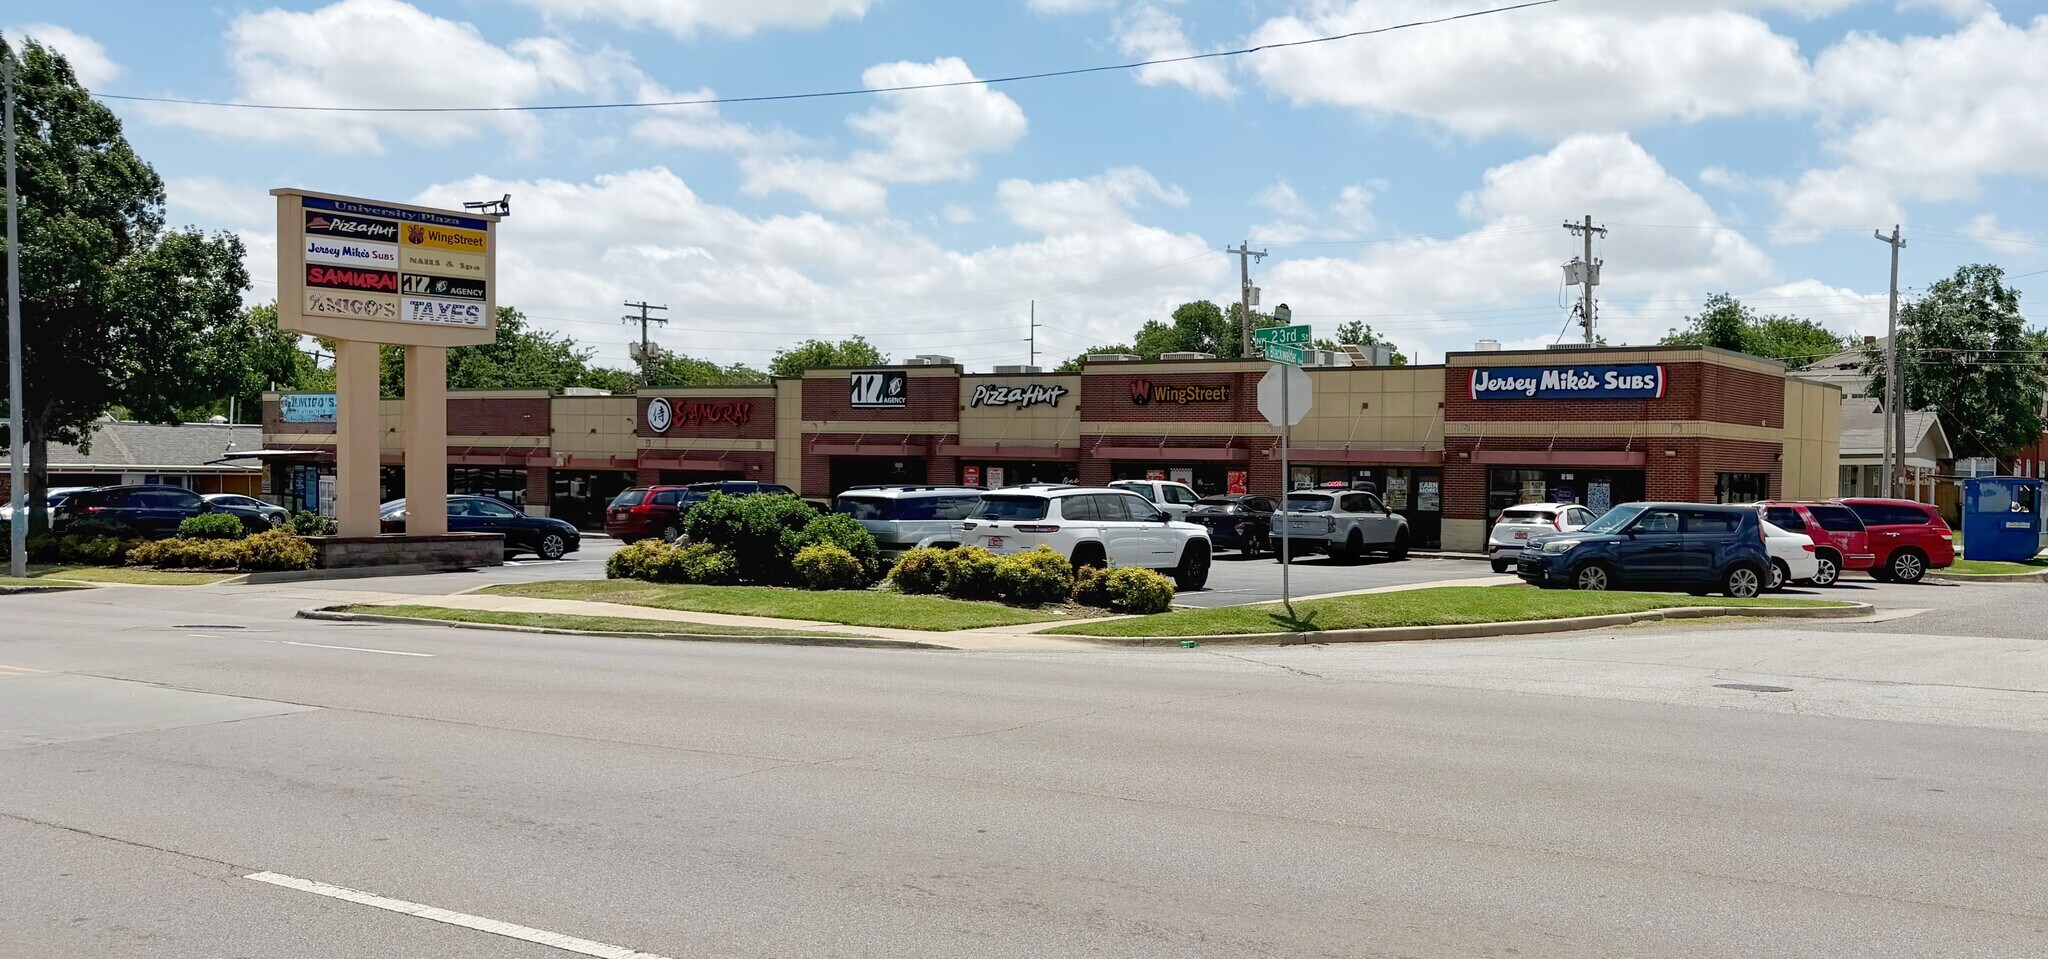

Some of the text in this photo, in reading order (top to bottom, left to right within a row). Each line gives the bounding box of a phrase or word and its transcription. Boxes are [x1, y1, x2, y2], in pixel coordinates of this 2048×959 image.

[334, 201, 460, 225] University Plaza
[428, 231, 483, 246] WingStreet
[308, 243, 340, 258] Jersey
[342, 246, 370, 258] Mike's
[308, 267, 396, 290] SAMURAI
[450, 287, 484, 296] AGENCY
[409, 300, 480, 324] TAXES
[1271, 328, 1297, 343] 23rd
[1475, 369, 1655, 397] Jersey Mike's SUBS
[1154, 385, 1226, 404] WingStreet
[673, 399, 749, 427] SAMURAI
